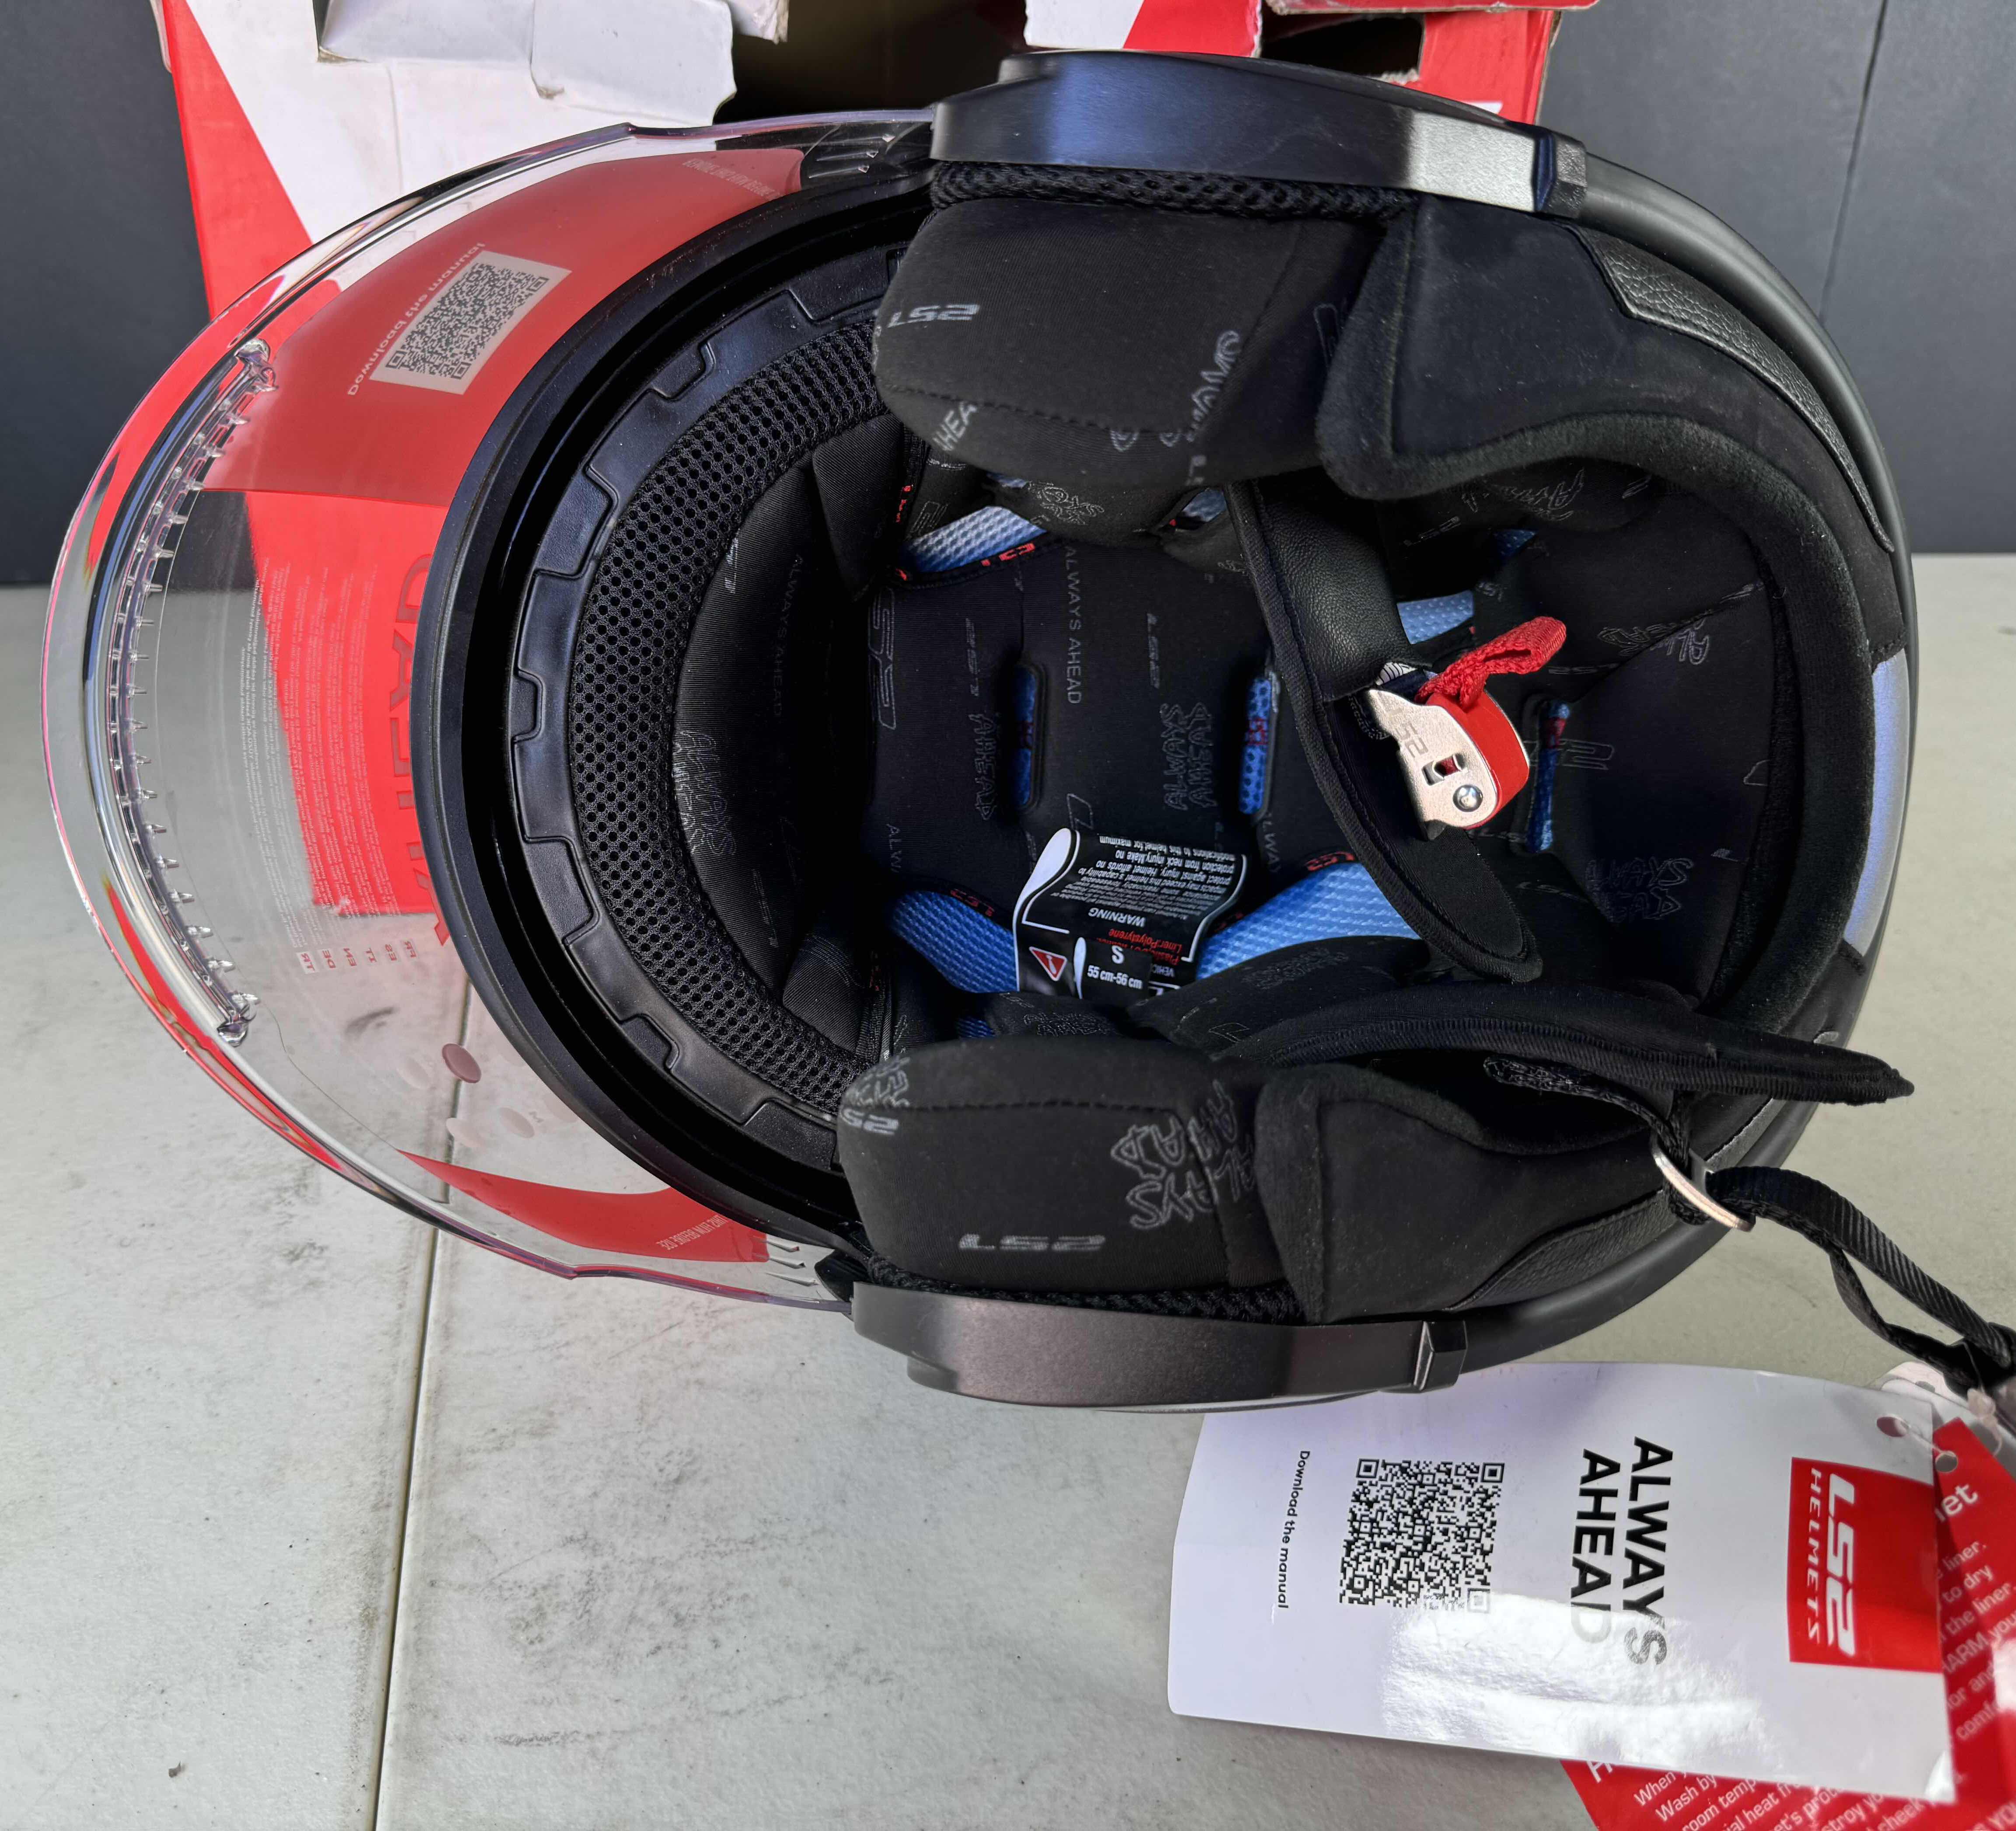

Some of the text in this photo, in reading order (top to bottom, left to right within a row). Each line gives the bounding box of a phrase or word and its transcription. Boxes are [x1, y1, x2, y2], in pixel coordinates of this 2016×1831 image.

[888, 304, 980, 328] LS2
[1065, 545, 1083, 704] ALWAYS AHEAD
[1115, 850, 1125, 859] no
[1166, 857, 1183, 867] neck
[1184, 847, 1191, 856] to
[1086, 867, 1119, 879] capability
[1107, 862, 1132, 872] affords
[1132, 865, 1157, 877] Helmet
[1180, 871, 1207, 881] against
[1184, 860, 1200, 871] from
[1088, 907, 1146, 927] WARNING
[1111, 945, 1125, 964] S
[1087, 965, 1143, 989] 55 cm-56 cm
[958, 1232, 1106, 1252] LS2
[1277, 1449, 1310, 1609] Download the manual
[1570, 1448, 1621, 1644] AHEAD
[1623, 1435, 1674, 1666] ALWAYS
[1805, 1466, 1822, 1645] HELMETS
[1826, 1472, 1856, 1657] LS2
[1941, 1586, 1962, 1603] to
[1964, 1565, 1994, 1589] dry
[1946, 1610, 1974, 1635] the
[1634, 1771, 1676, 1807] When
[1655, 1774, 1717, 1823] Wash by
[1742, 1792, 1779, 1825] heat
